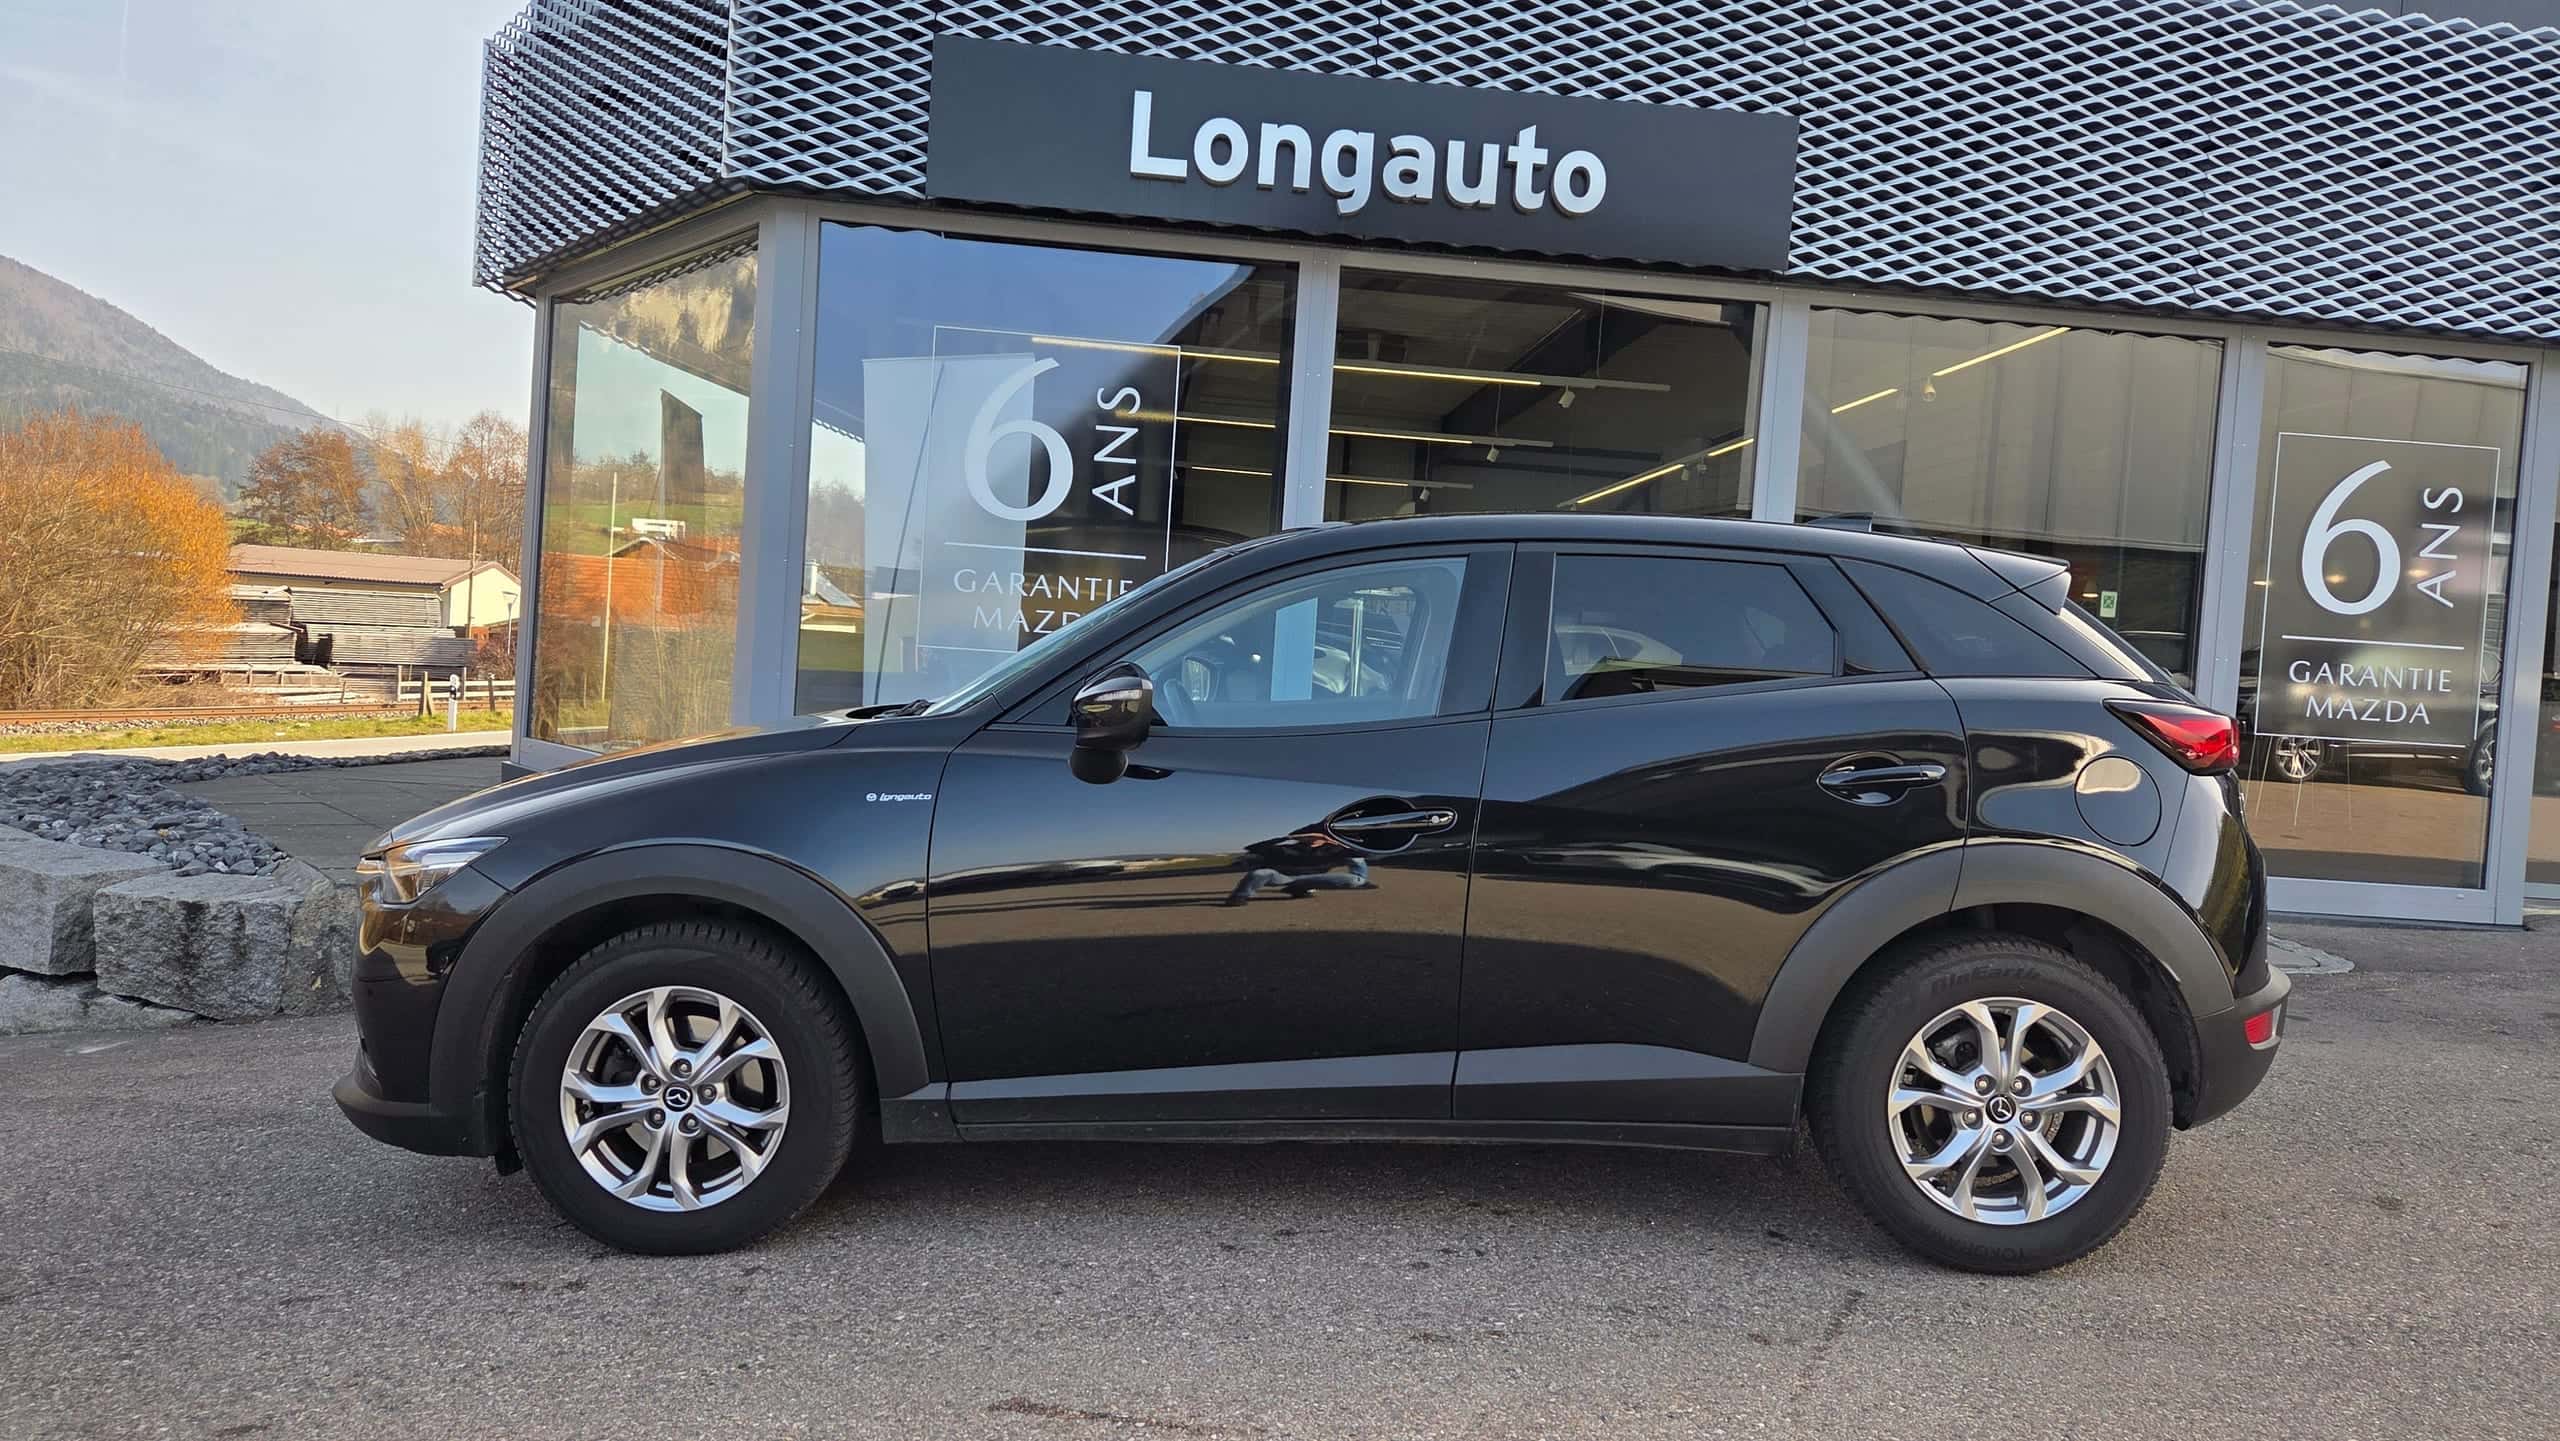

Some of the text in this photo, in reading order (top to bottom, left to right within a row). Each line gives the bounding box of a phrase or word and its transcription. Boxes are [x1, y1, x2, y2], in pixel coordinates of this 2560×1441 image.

[1129, 90, 1608, 216] Longauto
[964, 357, 1074, 521] 6
[1092, 386, 1141, 515] ANS
[2301, 459, 2401, 615] 6
[2417, 486, 2463, 608] ANS
[2289, 659, 2453, 693] GARANTIE
[2305, 695, 2431, 725] MAZDA
